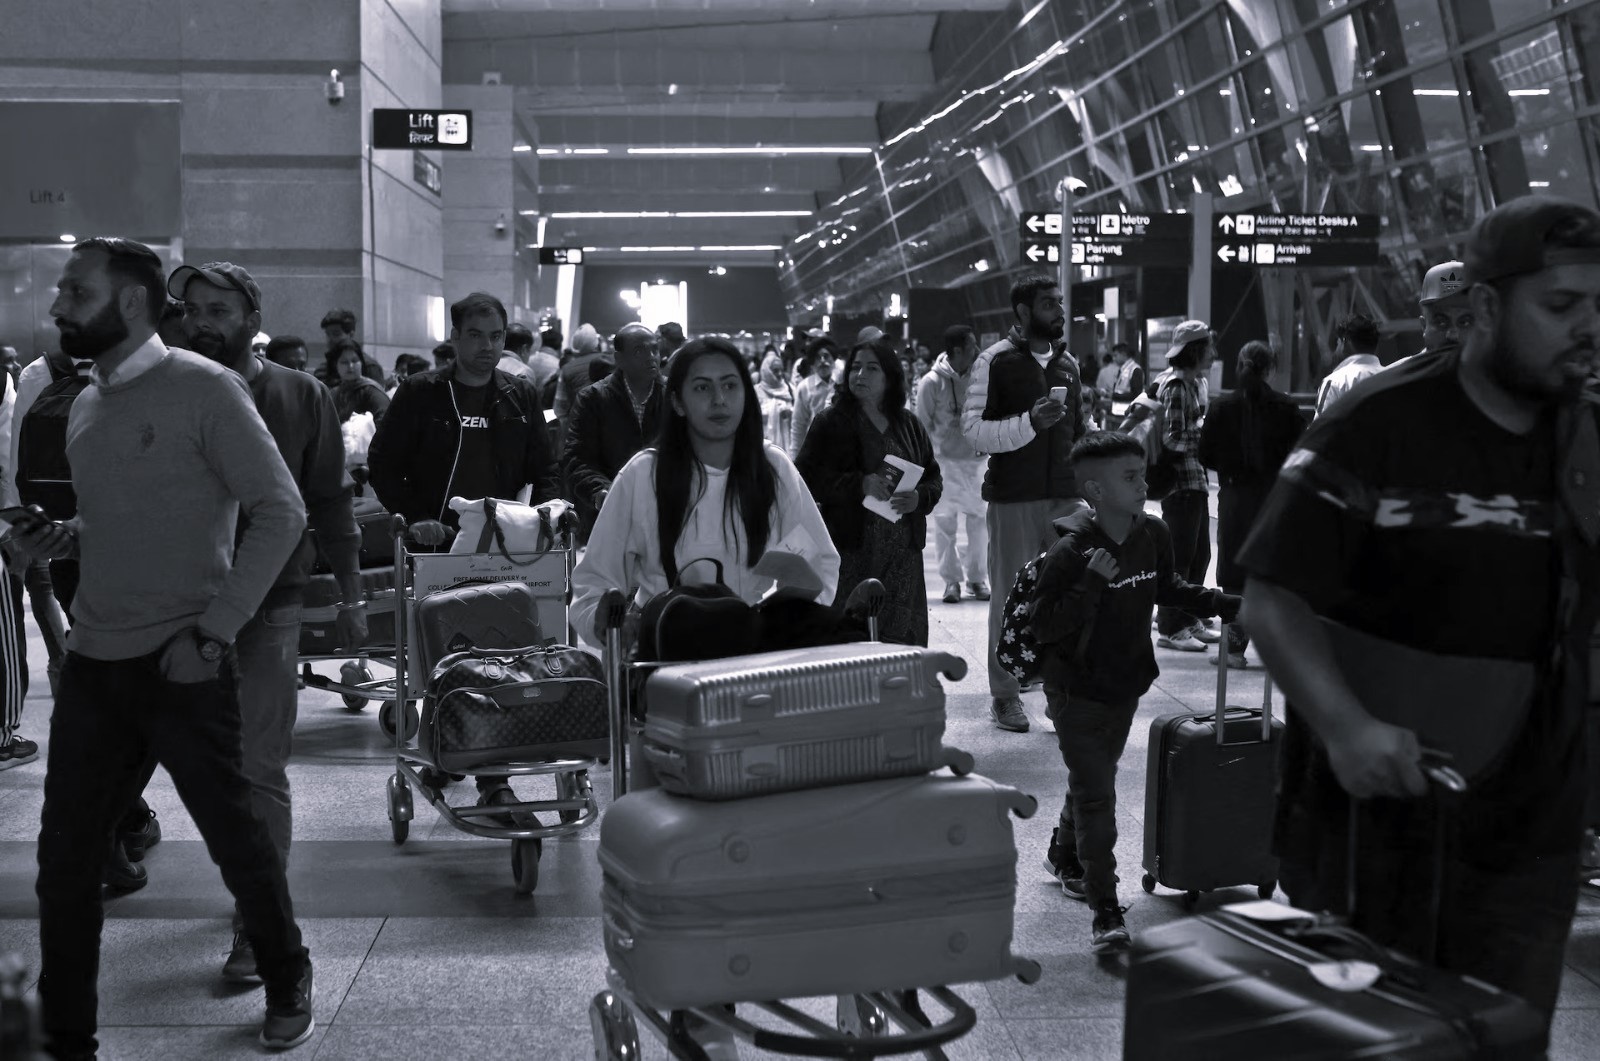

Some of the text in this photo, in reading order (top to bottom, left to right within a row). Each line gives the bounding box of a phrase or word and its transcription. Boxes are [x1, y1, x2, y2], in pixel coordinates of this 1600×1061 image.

[409, 113, 434, 128] Lift
[30, 189, 54, 204] Lift
[1072, 215, 1096, 225] uses
[1122, 215, 1150, 225] Metro
[1256, 215, 1358, 226] Airline Ticket Desks A
[1086, 244, 1123, 256] Parking
[1276, 244, 1311, 254] Arrivals
[462, 416, 489, 428] ZEN
